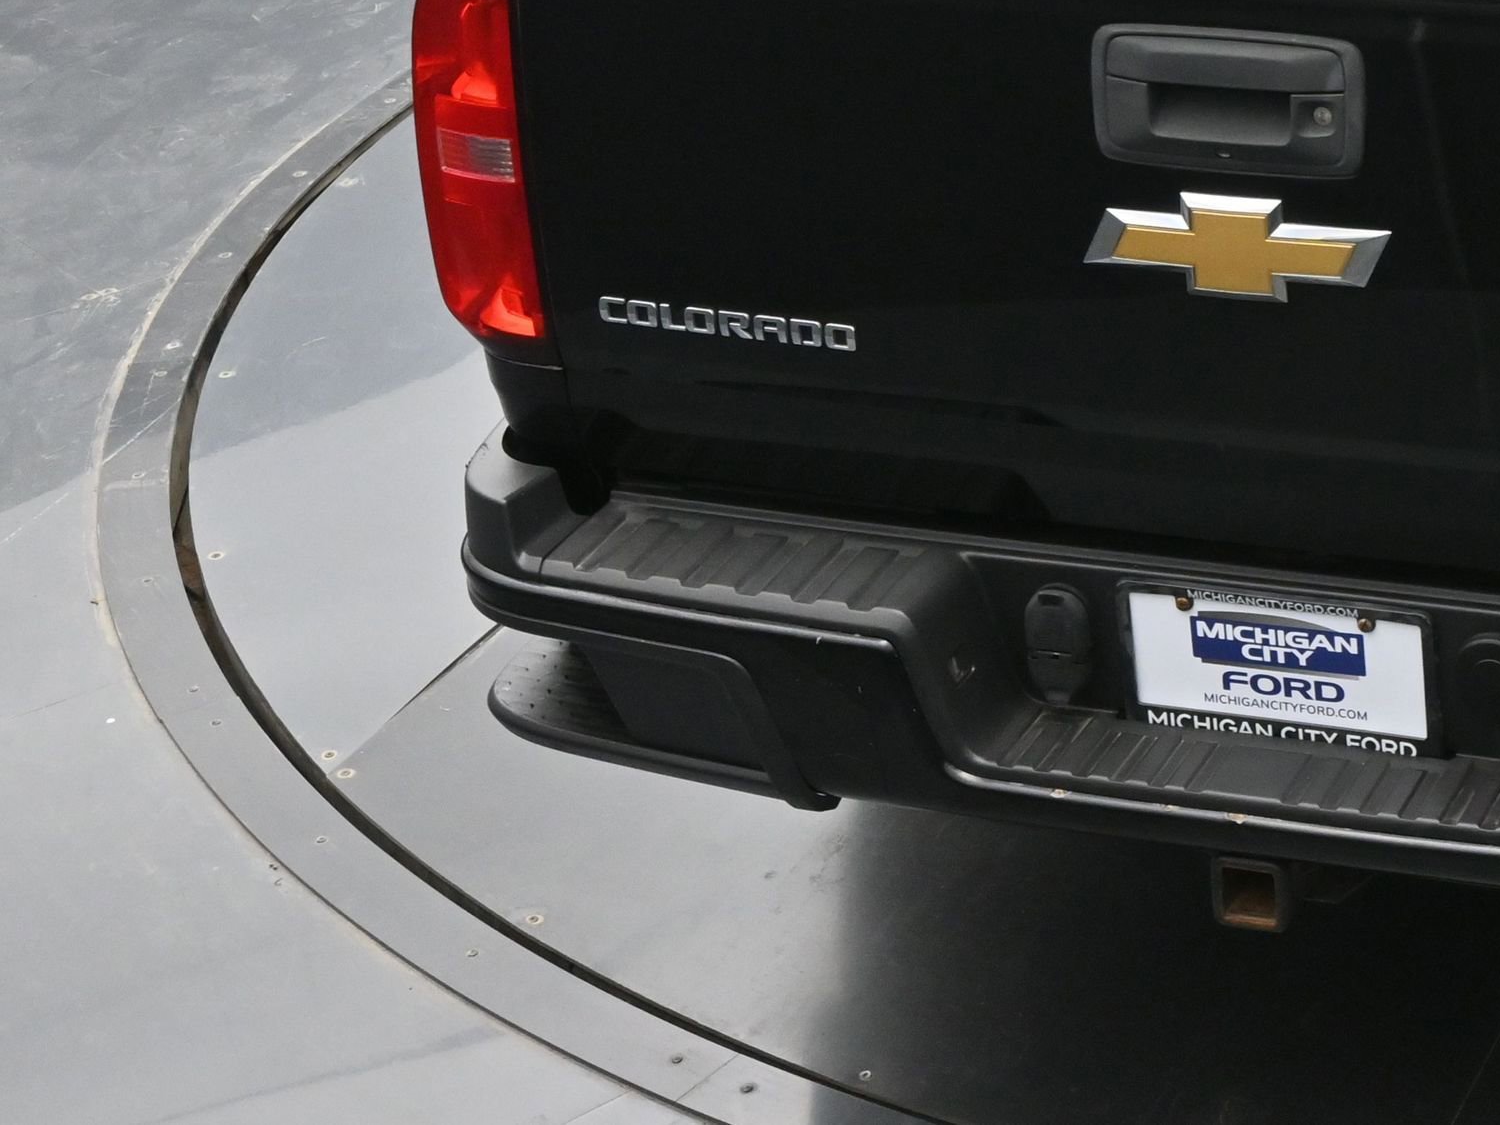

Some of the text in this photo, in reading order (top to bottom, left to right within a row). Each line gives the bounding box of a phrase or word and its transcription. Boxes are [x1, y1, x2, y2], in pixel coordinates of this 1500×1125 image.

[599, 296, 856, 351] COLORADO
[1186, 589, 1359, 618] MICHIGANCITYFORD.COM
[1196, 620, 1358, 655] MICHIGAN
[1241, 644, 1315, 667] CITY
[1222, 671, 1345, 703] FORD
[1203, 693, 1368, 721] MICHIGANCITYFORD.COM
[1147, 709, 1418, 757] MICHIGAN CITY FORD
